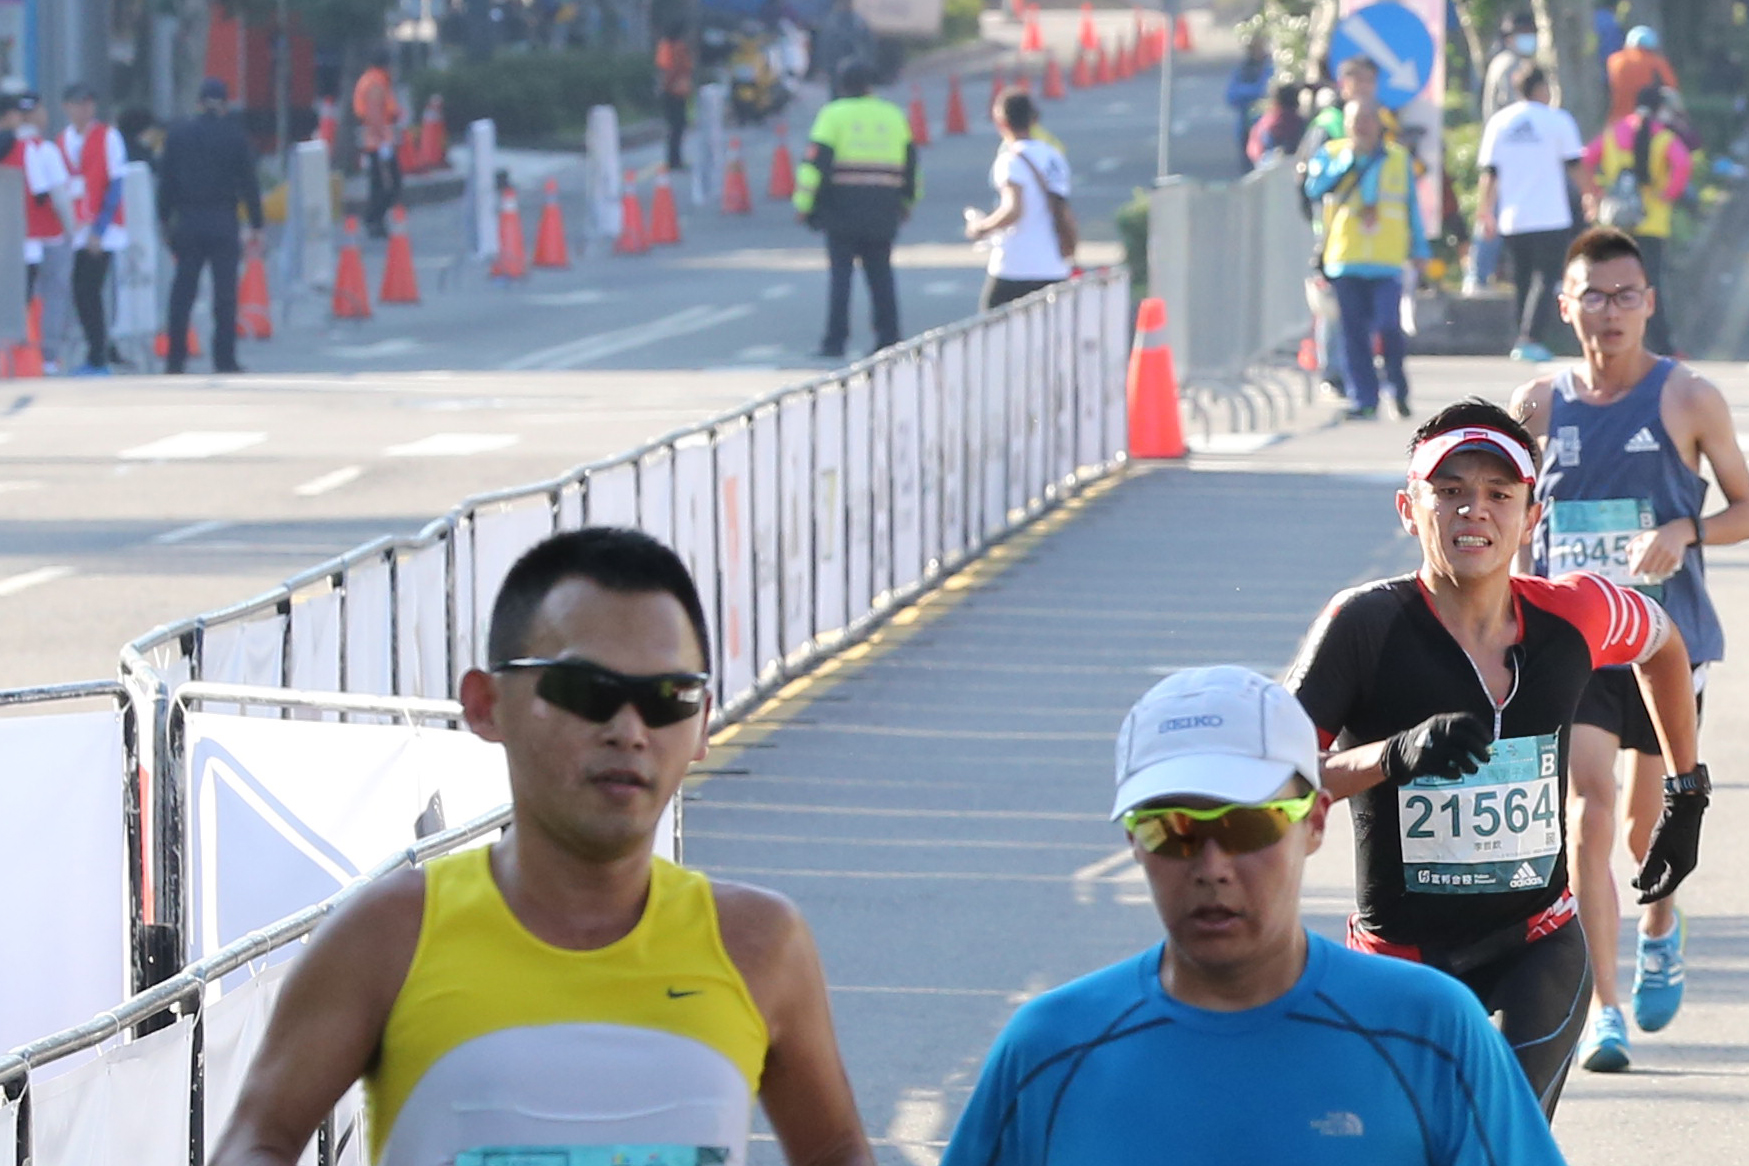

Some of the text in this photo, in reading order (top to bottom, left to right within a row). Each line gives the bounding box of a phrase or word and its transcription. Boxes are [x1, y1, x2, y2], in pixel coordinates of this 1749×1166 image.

[1158, 714, 1223, 734] SEIKO
[1541, 753, 1556, 776] B
[1404, 783, 1555, 838] 21564
